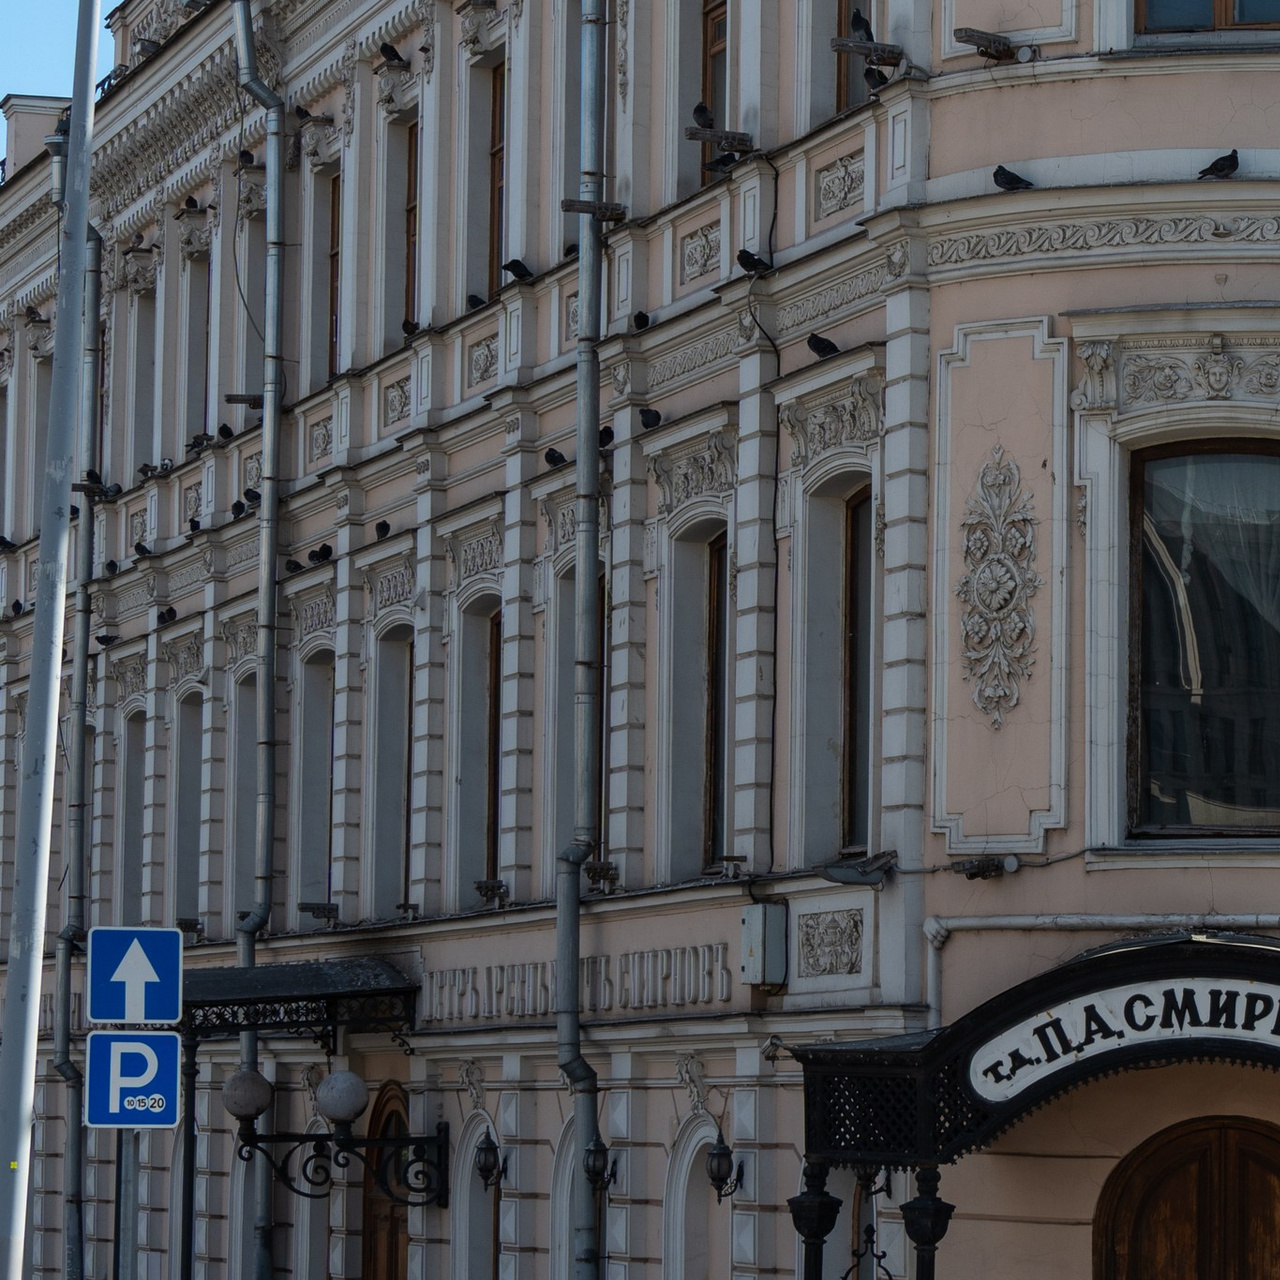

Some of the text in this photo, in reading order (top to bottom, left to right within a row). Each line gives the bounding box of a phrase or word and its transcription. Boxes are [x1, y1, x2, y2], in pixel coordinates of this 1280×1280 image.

[109, 1042, 158, 1113] P
[126, 1097, 165, 1109] 10 15 20
